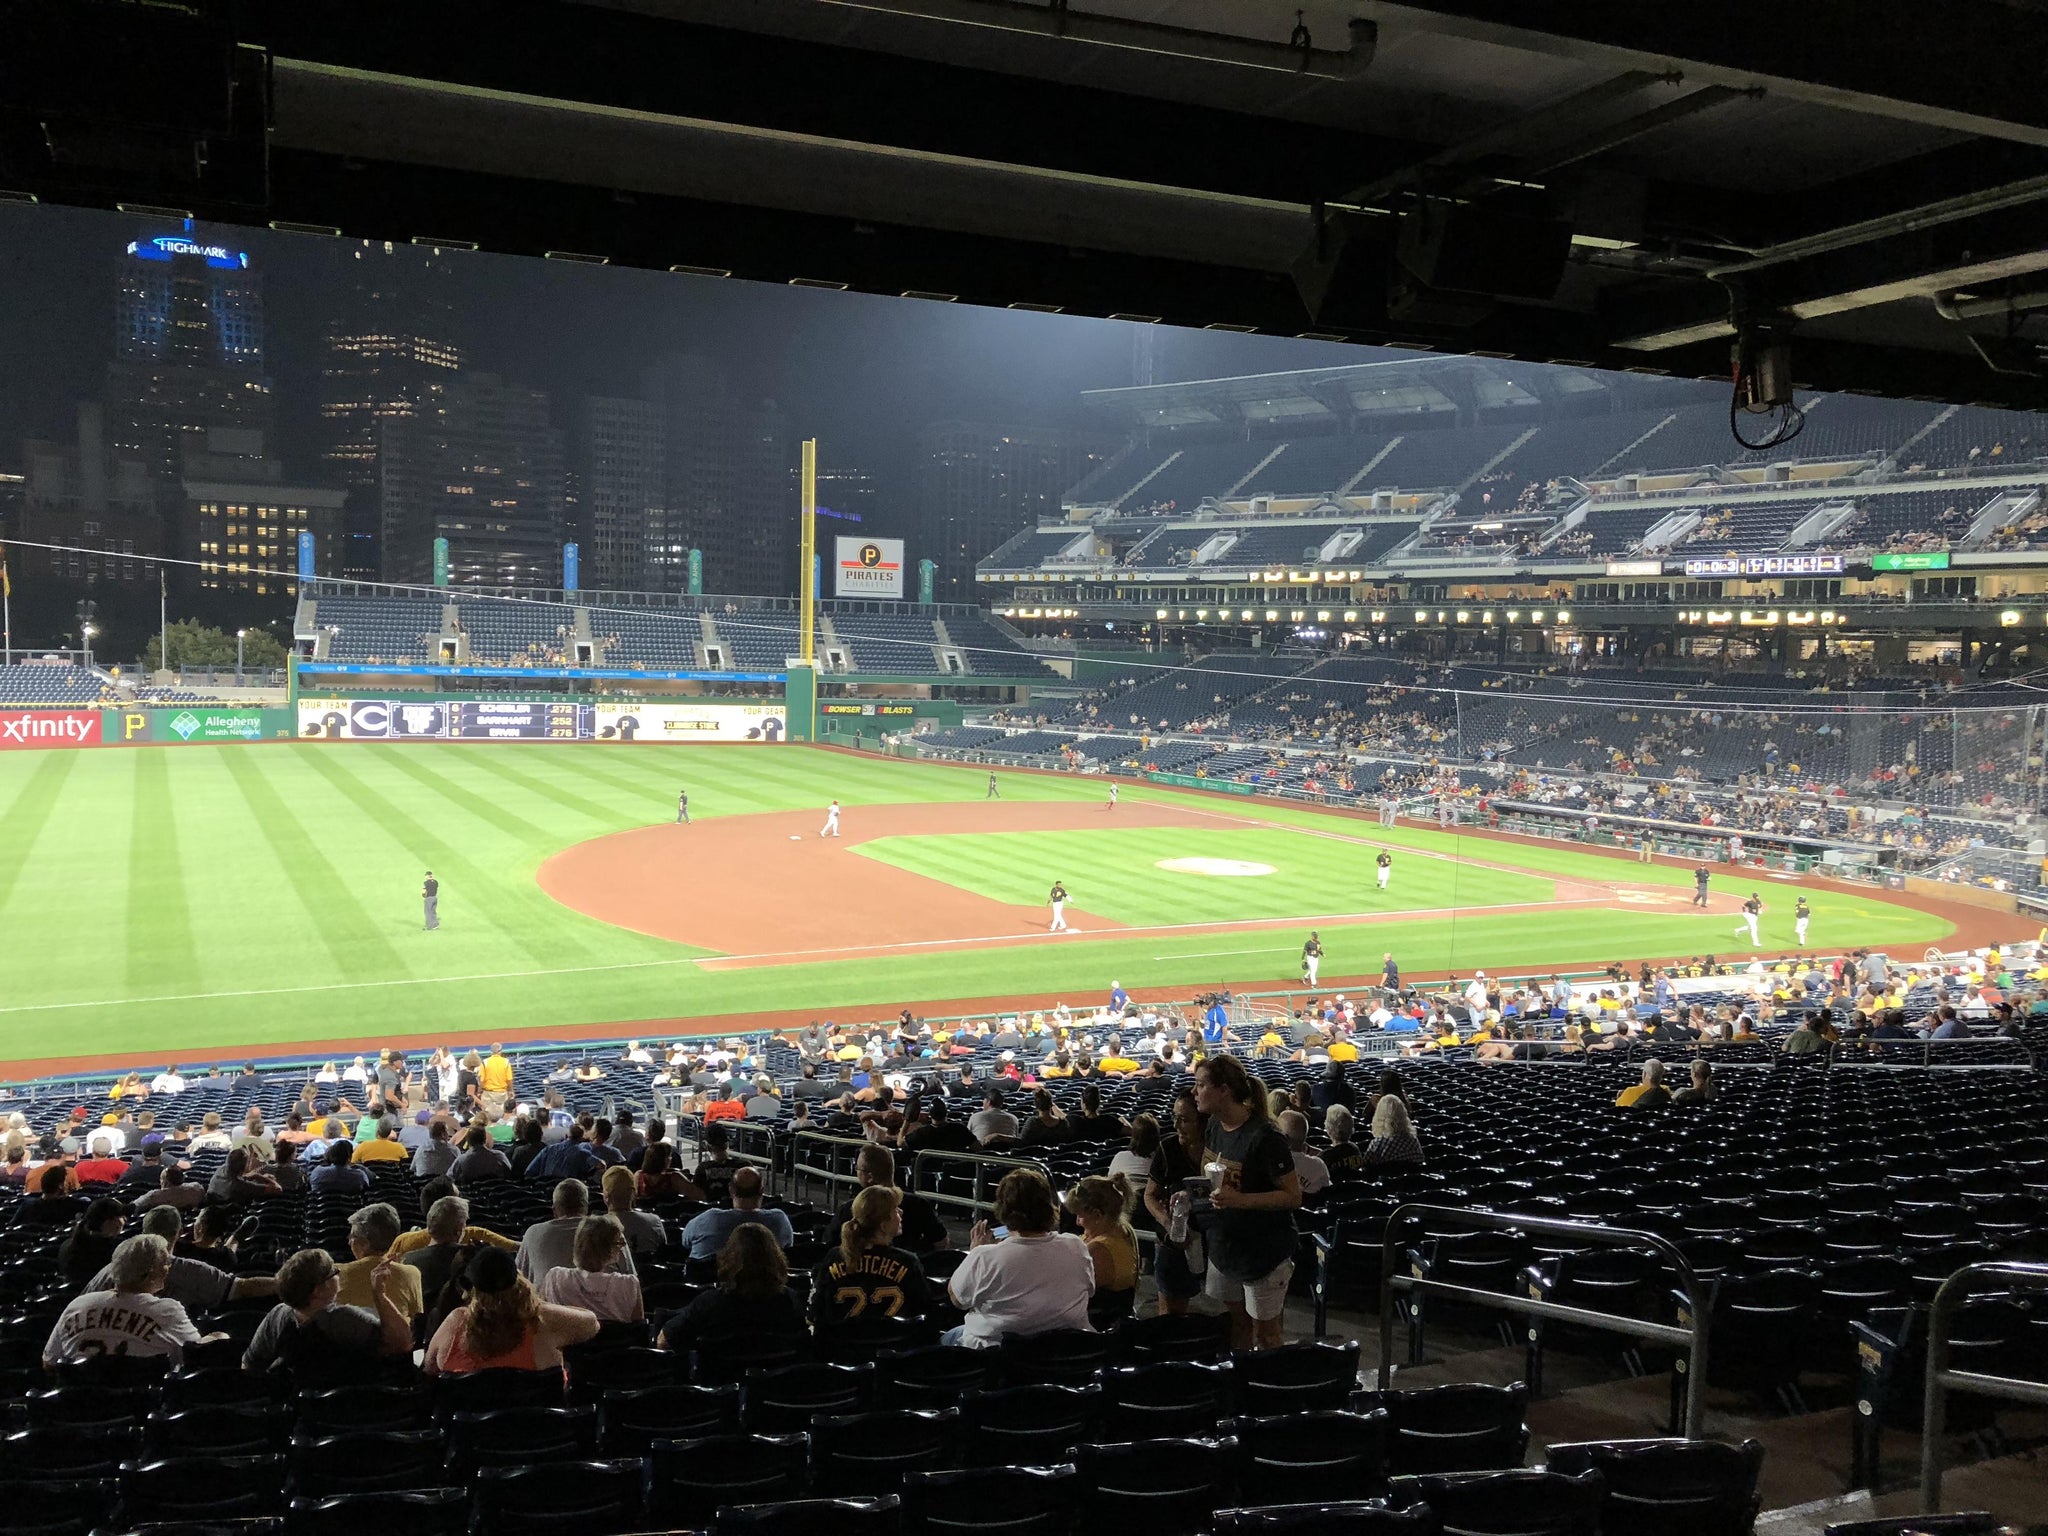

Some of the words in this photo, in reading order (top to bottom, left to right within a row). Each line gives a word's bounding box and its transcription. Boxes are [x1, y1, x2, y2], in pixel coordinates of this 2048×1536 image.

[159, 241, 226, 259] HIGHMARK
[865, 549, 877, 564] P
[846, 571, 894, 581] PIRATES
[1156, 610, 1385, 622] PITTSBURGH
[1414, 611, 1567, 623] PIRATES
[299, 701, 322, 709] YOUR
[551, 705, 573, 713] .272
[597, 705, 616, 713] YOUR
[620, 705, 641, 713] TEAM
[828, 705, 862, 713] BOWSER
[883, 706, 914, 714] BLASTS
[743, 707, 762, 715] YOUR
[765, 708, 784, 716] GEAR
[125, 713, 145, 739] P
[205, 716, 260, 729] Allegheny
[2, 714, 94, 743] xfinity
[205, 728, 229, 737] Health
[230, 728, 261, 737] Network
